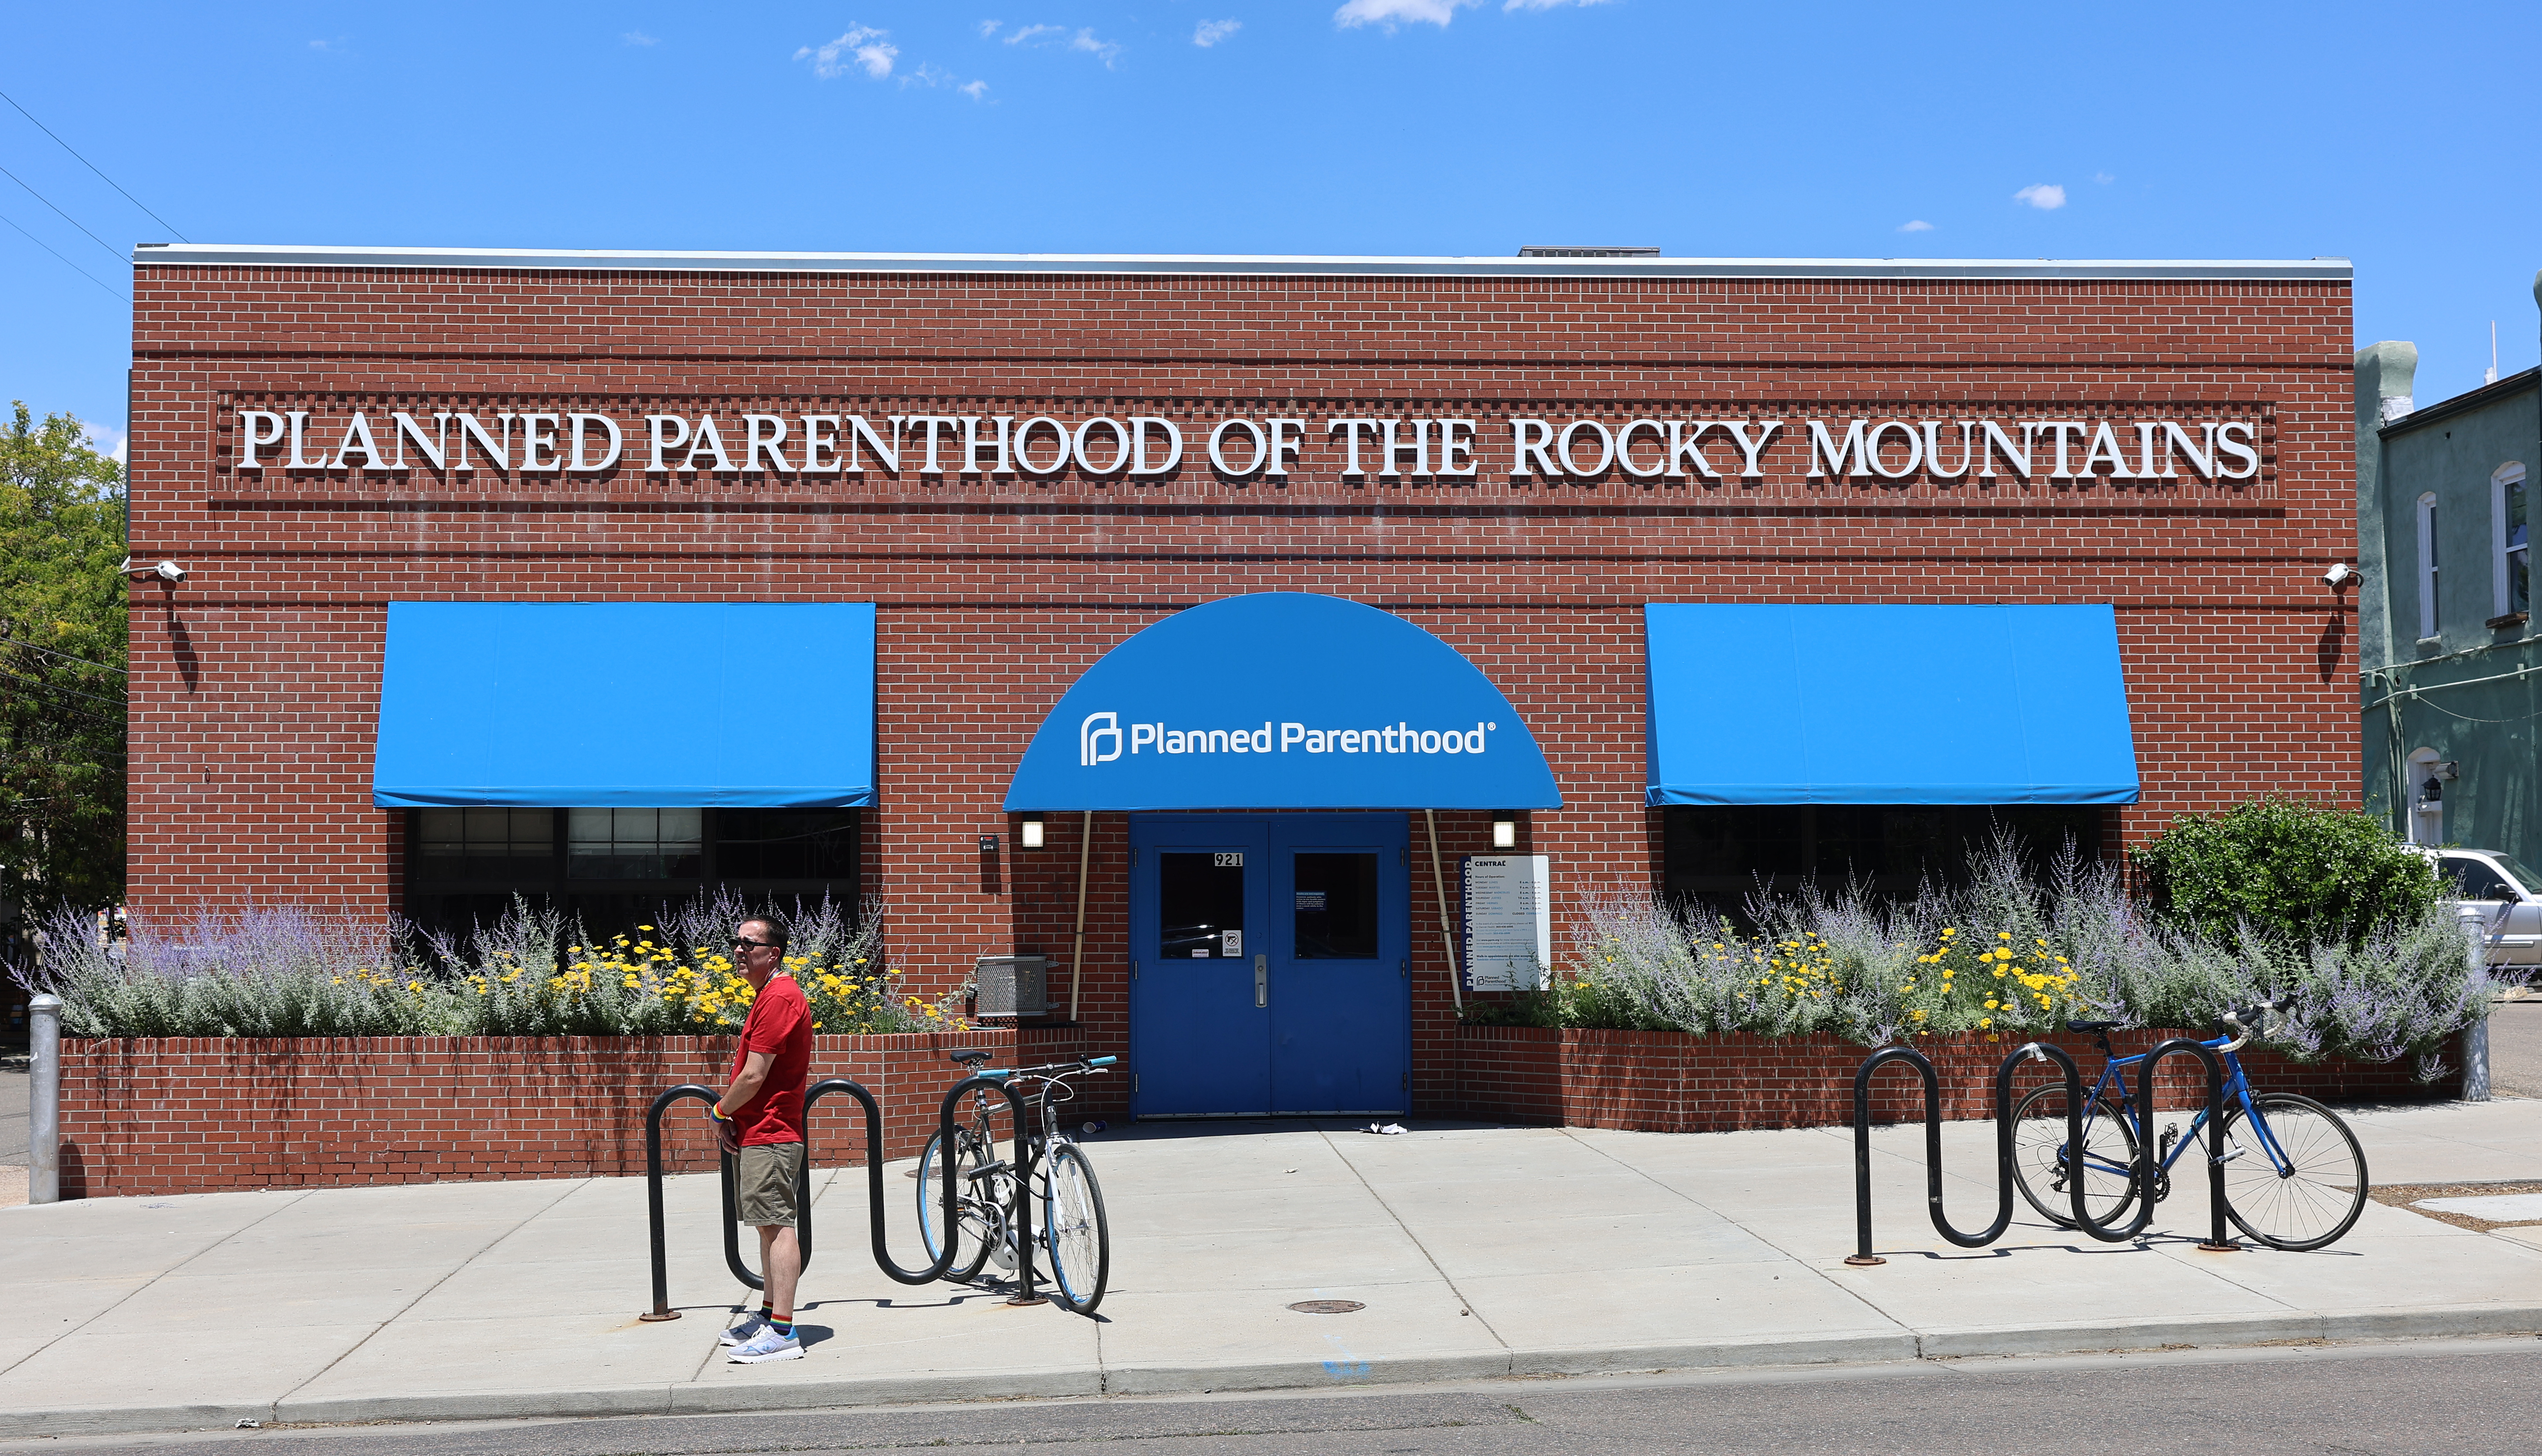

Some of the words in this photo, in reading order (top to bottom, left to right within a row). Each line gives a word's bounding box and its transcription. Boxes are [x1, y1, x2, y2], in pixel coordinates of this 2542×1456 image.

[237, 411, 621, 471] PLANNED
[645, 414, 1182, 473] PARENTHOOD
[1209, 418, 1305, 475] OF
[1328, 419, 1477, 475] THE
[1509, 419, 1783, 476] ROCKY
[1807, 420, 2257, 478] MOUNTAINS
[1132, 722, 1271, 754] Planned
[1216, 853, 1240, 865] 921
[1464, 861, 1473, 934] PARENTHOOD
